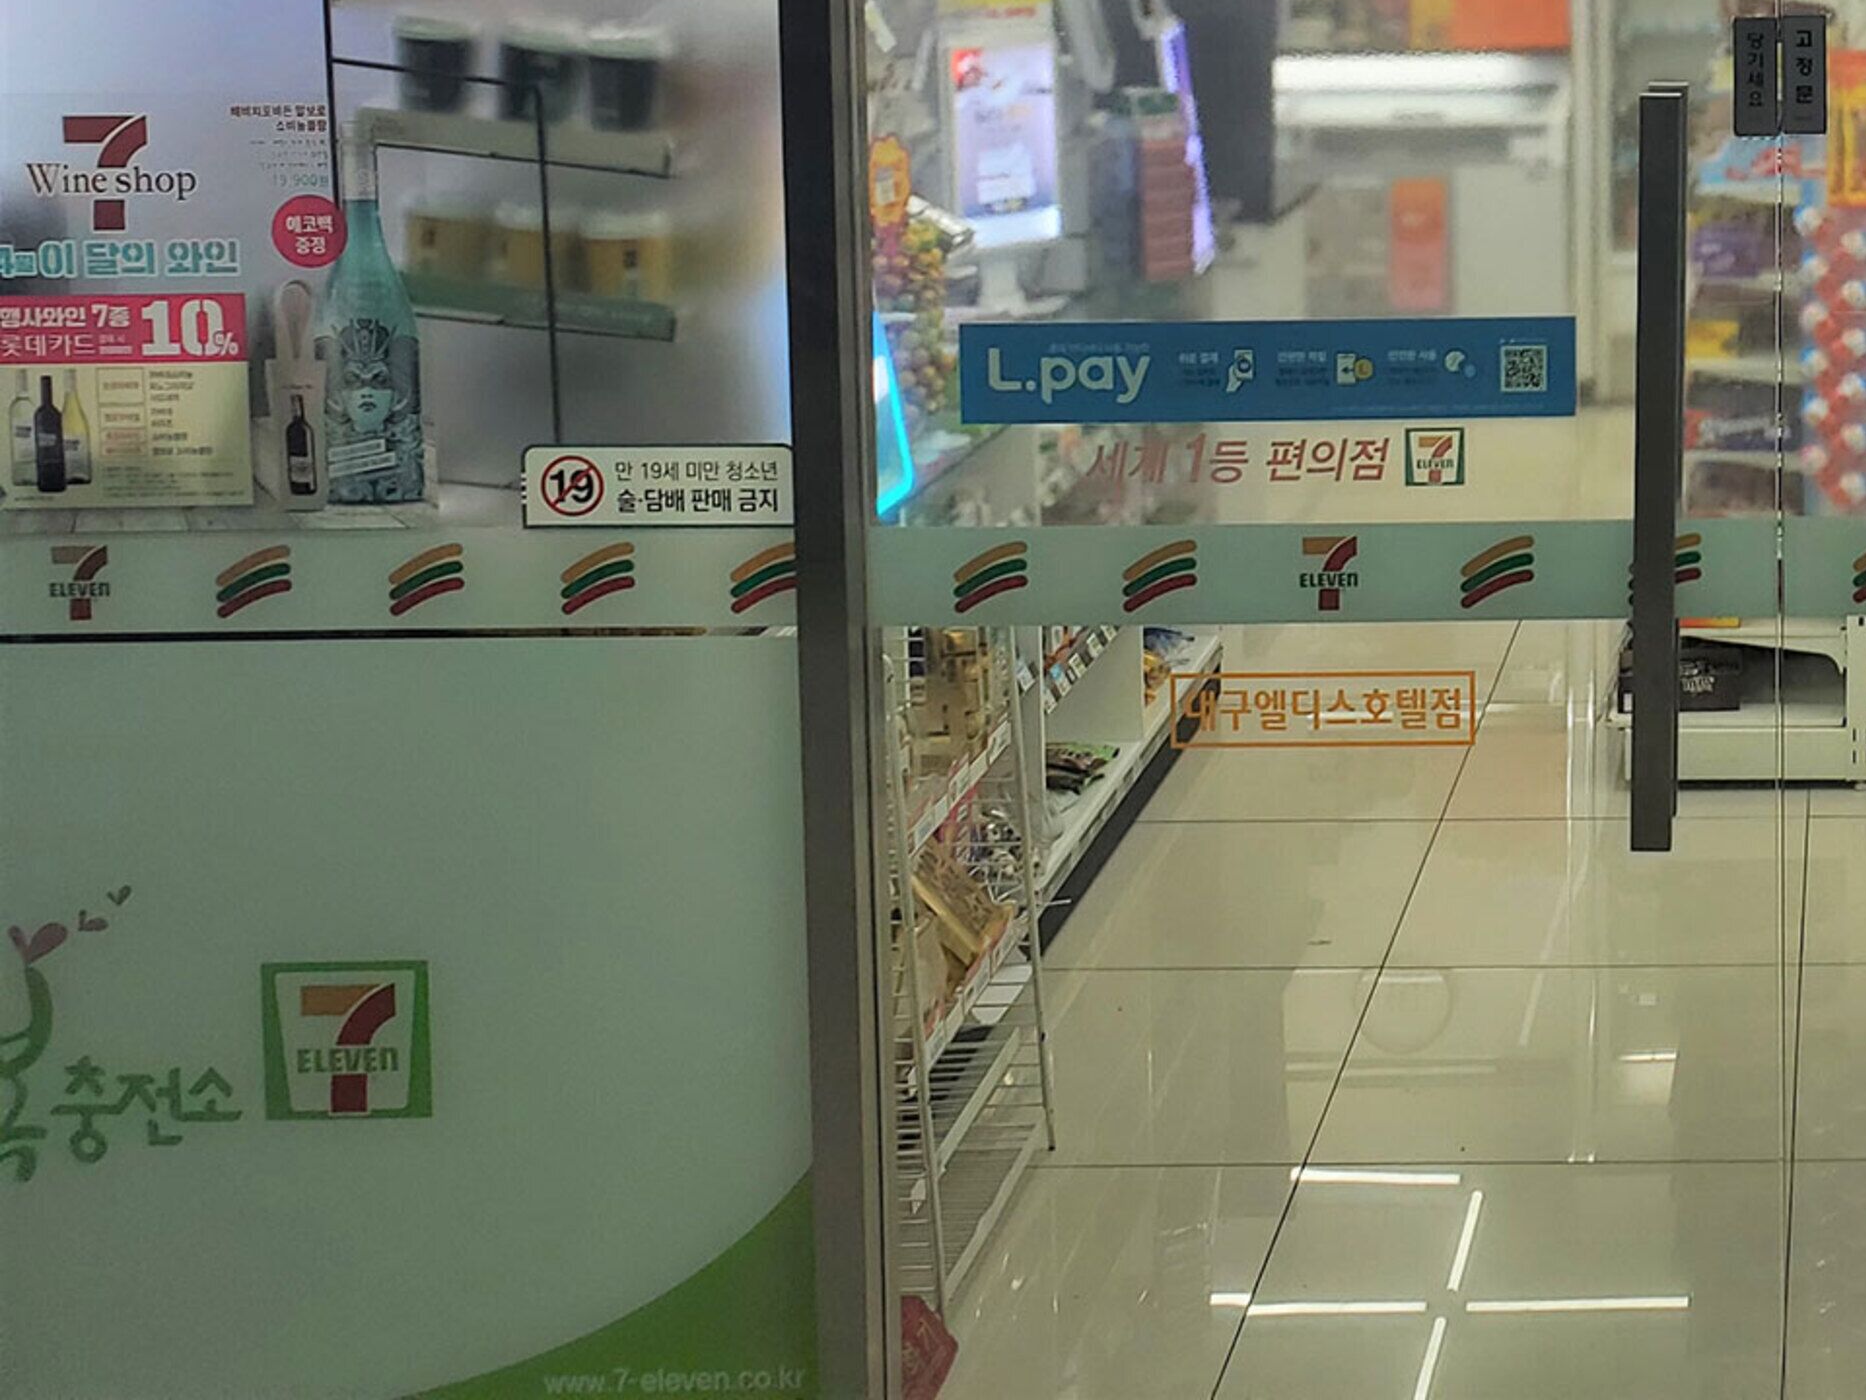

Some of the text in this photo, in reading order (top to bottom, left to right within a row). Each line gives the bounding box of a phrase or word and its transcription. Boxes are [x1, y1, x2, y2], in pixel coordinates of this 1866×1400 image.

[1746, 31, 1765, 108] 당기세요
[1795, 29, 1814, 105] 고정문
[26, 163, 198, 201] Wine shop
[85, 240, 156, 277] 달의
[165, 239, 240, 276] 와인
[91, 304, 131, 328] 7종
[141, 298, 240, 358] 10%
[986, 347, 1151, 404] L.pay
[614, 460, 779, 482] 만 19세 미만 청소년
[1184, 432, 1250, 484] 1등
[1265, 436, 1391, 483] 편의점
[691, 489, 732, 513] 판매
[737, 488, 779, 513] 금지
[1182, 687, 1463, 732] 대구엘디스호텔점
